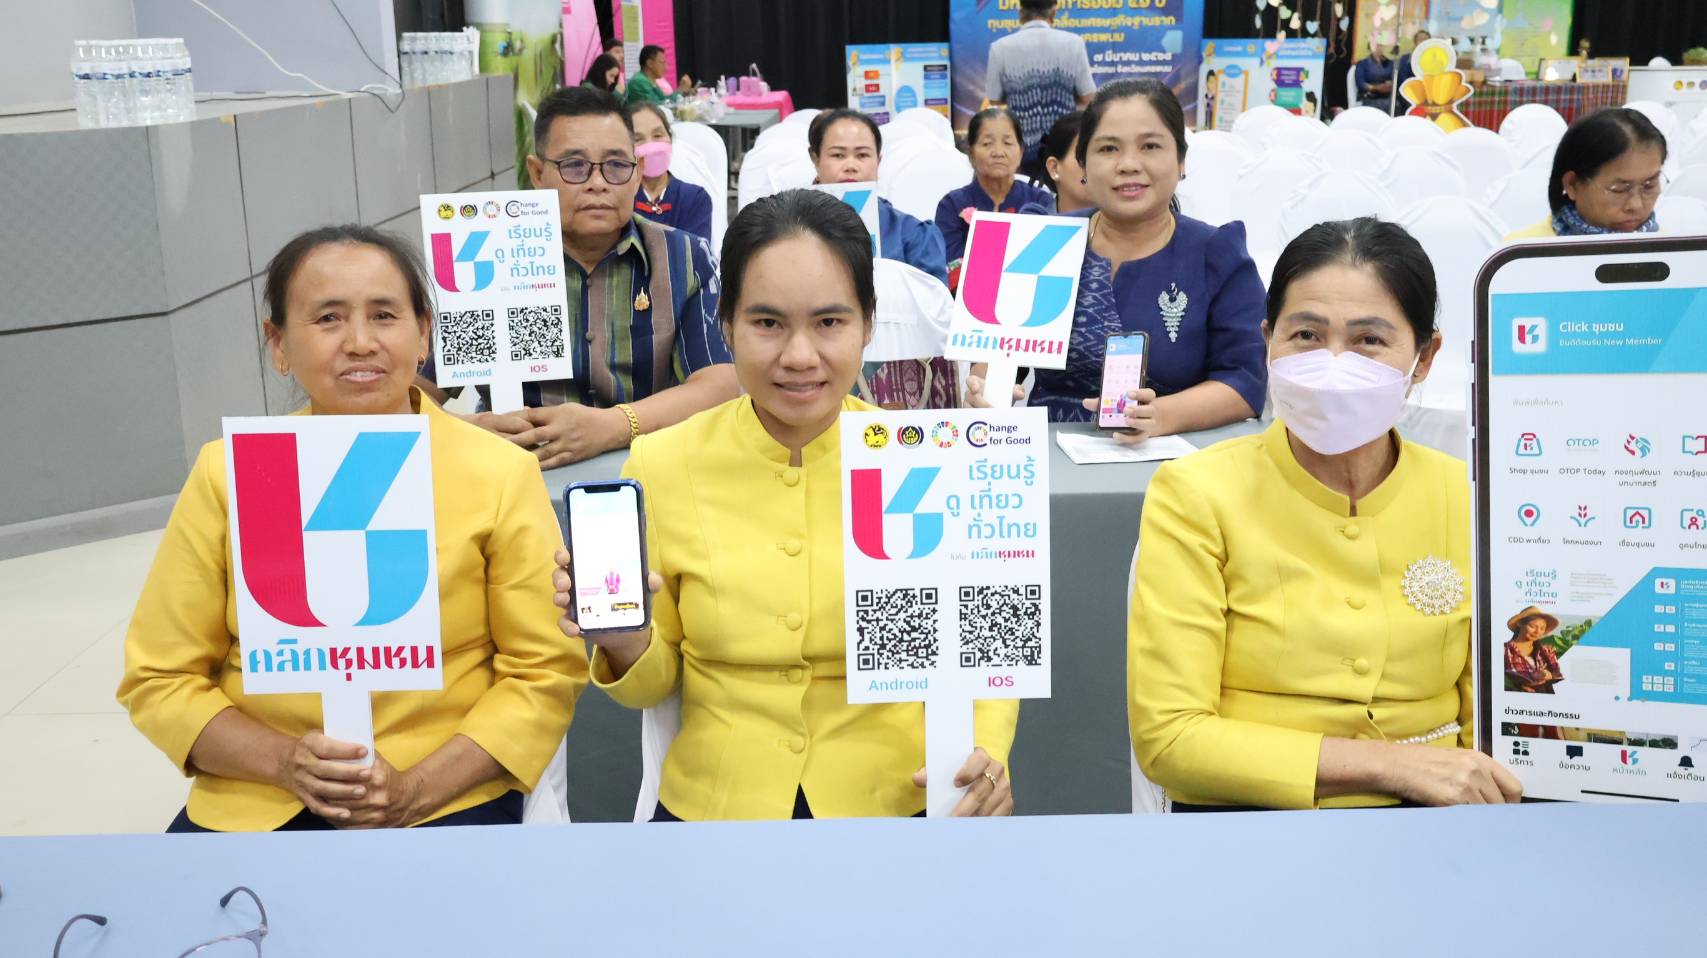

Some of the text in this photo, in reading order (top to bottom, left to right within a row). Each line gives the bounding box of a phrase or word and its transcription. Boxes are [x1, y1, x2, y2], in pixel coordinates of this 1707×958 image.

[1105, 50, 1140, 62] มีนาคม
[508, 222, 553, 241] เรียนรู้
[495, 240, 546, 263] ดู เที่ยว
[510, 260, 556, 277] ทั่วไทย
[1559, 321, 1589, 333] Click
[951, 329, 1064, 358] คลิกชุมชน
[1603, 337, 1623, 346] New
[1625, 336, 1663, 346] Member
[451, 367, 492, 379] Android
[989, 435, 1031, 446] for Good
[1566, 438, 1599, 447] OTOP
[968, 457, 1036, 486] เรียนรู้
[1509, 467, 1528, 476] Shop
[1583, 468, 1606, 477] Today
[946, 482, 1023, 517] ดู เที่ยว
[967, 512, 1037, 539] ทั่วไทย
[1508, 536, 1524, 544] CDD
[1525, 568, 1557, 580] เรียนรู้
[1526, 577, 1551, 588] เที่ยว
[1524, 588, 1558, 598] ทั่วไทย
[249, 638, 435, 682] คลิกชุมชน
[868, 675, 1015, 691] Android IOS
[1504, 707, 1581, 720] ข่าวสารและกิจกรรม
[1508, 757, 1534, 768] บริการ
[1558, 759, 1591, 772] ข้อความ
[1612, 765, 1647, 777] หน้าหลัก
[1666, 770, 1705, 782] แจ้งเตือน
